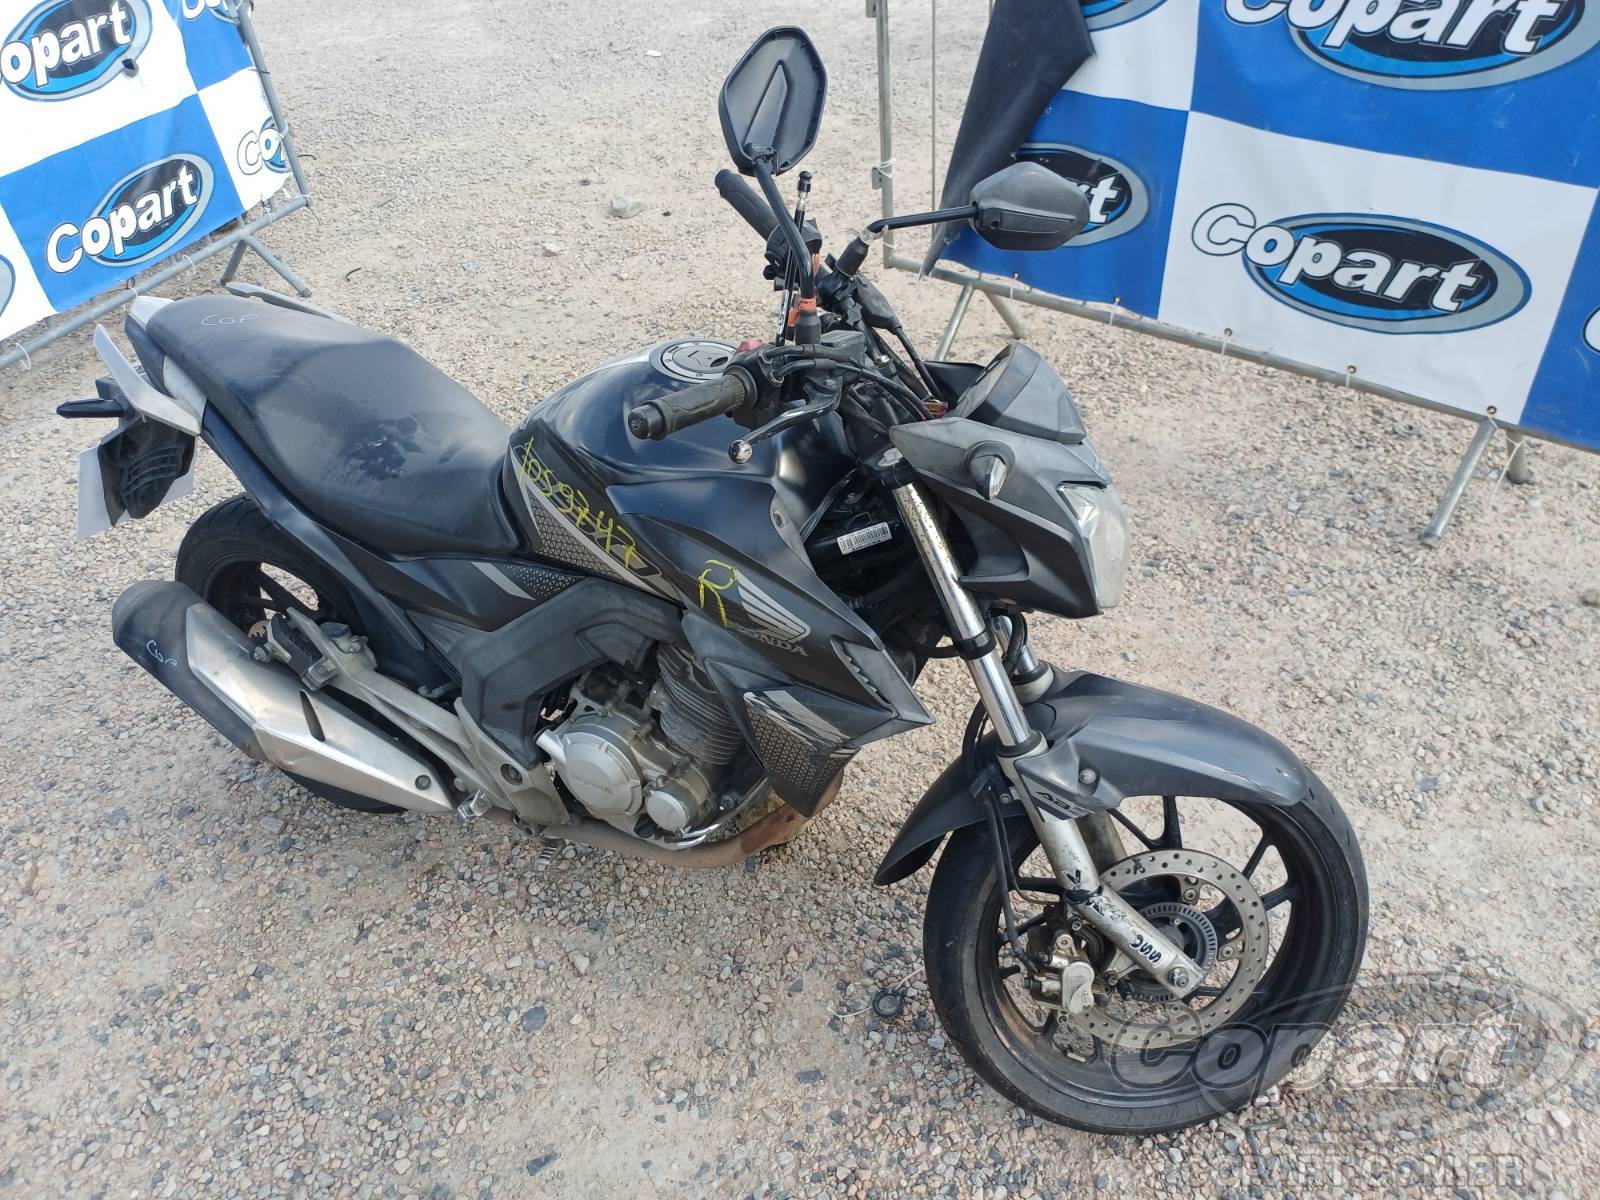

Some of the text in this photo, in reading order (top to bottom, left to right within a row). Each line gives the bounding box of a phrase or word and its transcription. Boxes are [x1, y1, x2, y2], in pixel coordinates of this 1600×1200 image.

[0, 0, 134, 88] opart
[45, 161, 200, 275] Copart
[1191, 202, 1483, 313] Copart
[697, 558, 738, 629] R
